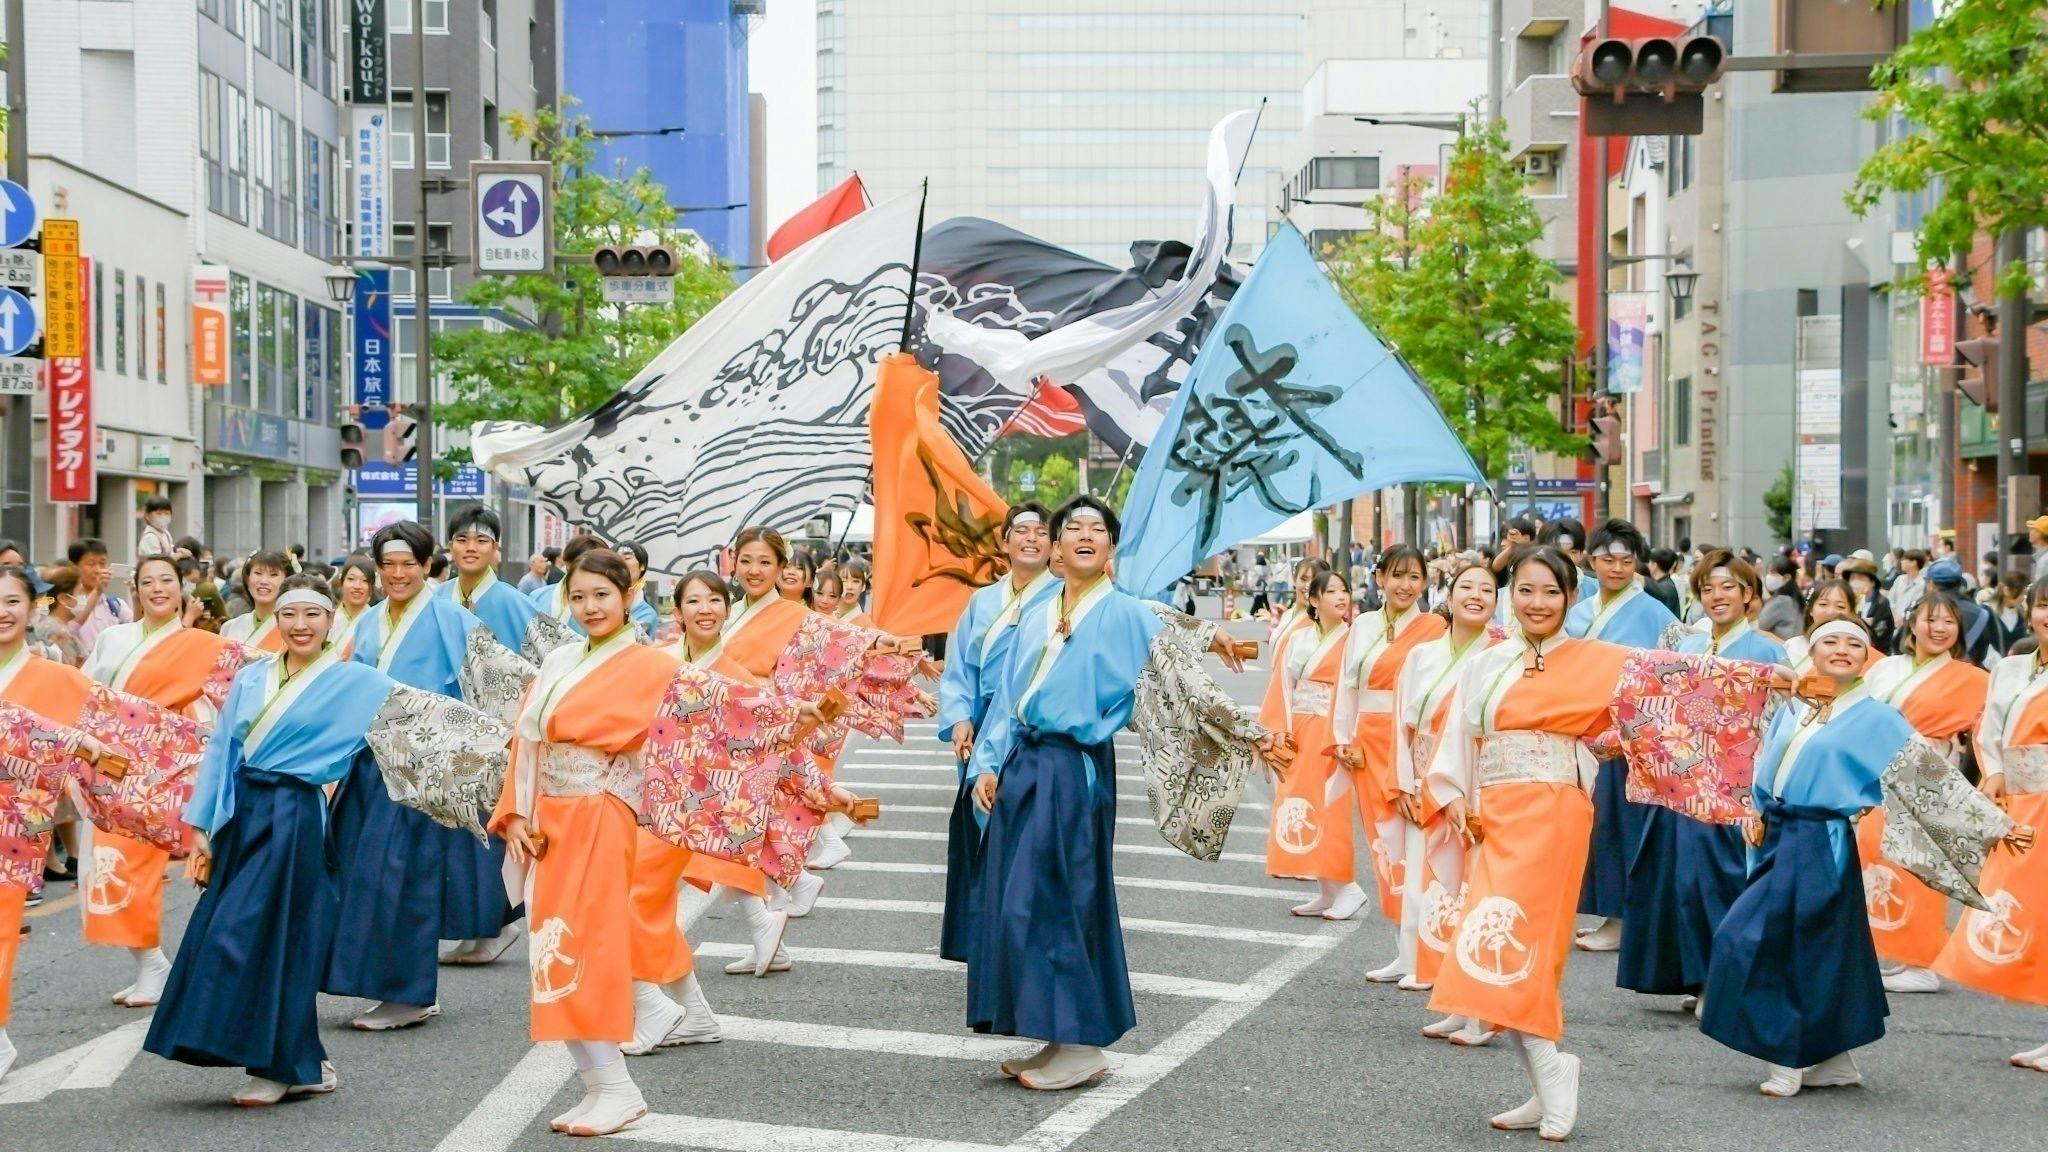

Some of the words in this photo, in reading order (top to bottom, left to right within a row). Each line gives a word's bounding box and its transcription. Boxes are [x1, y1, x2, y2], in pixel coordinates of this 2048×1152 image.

[356, 0, 375, 97] Workout
[485, 248, 538, 261] 自転車を除く
[609, 280, 668, 292] 歩車分離式
[1702, 301, 1719, 357] TAG
[364, 339, 382, 407] 日本旅行
[1702, 390, 1718, 482] Printing
[361, 471, 400, 481] 株式会社
